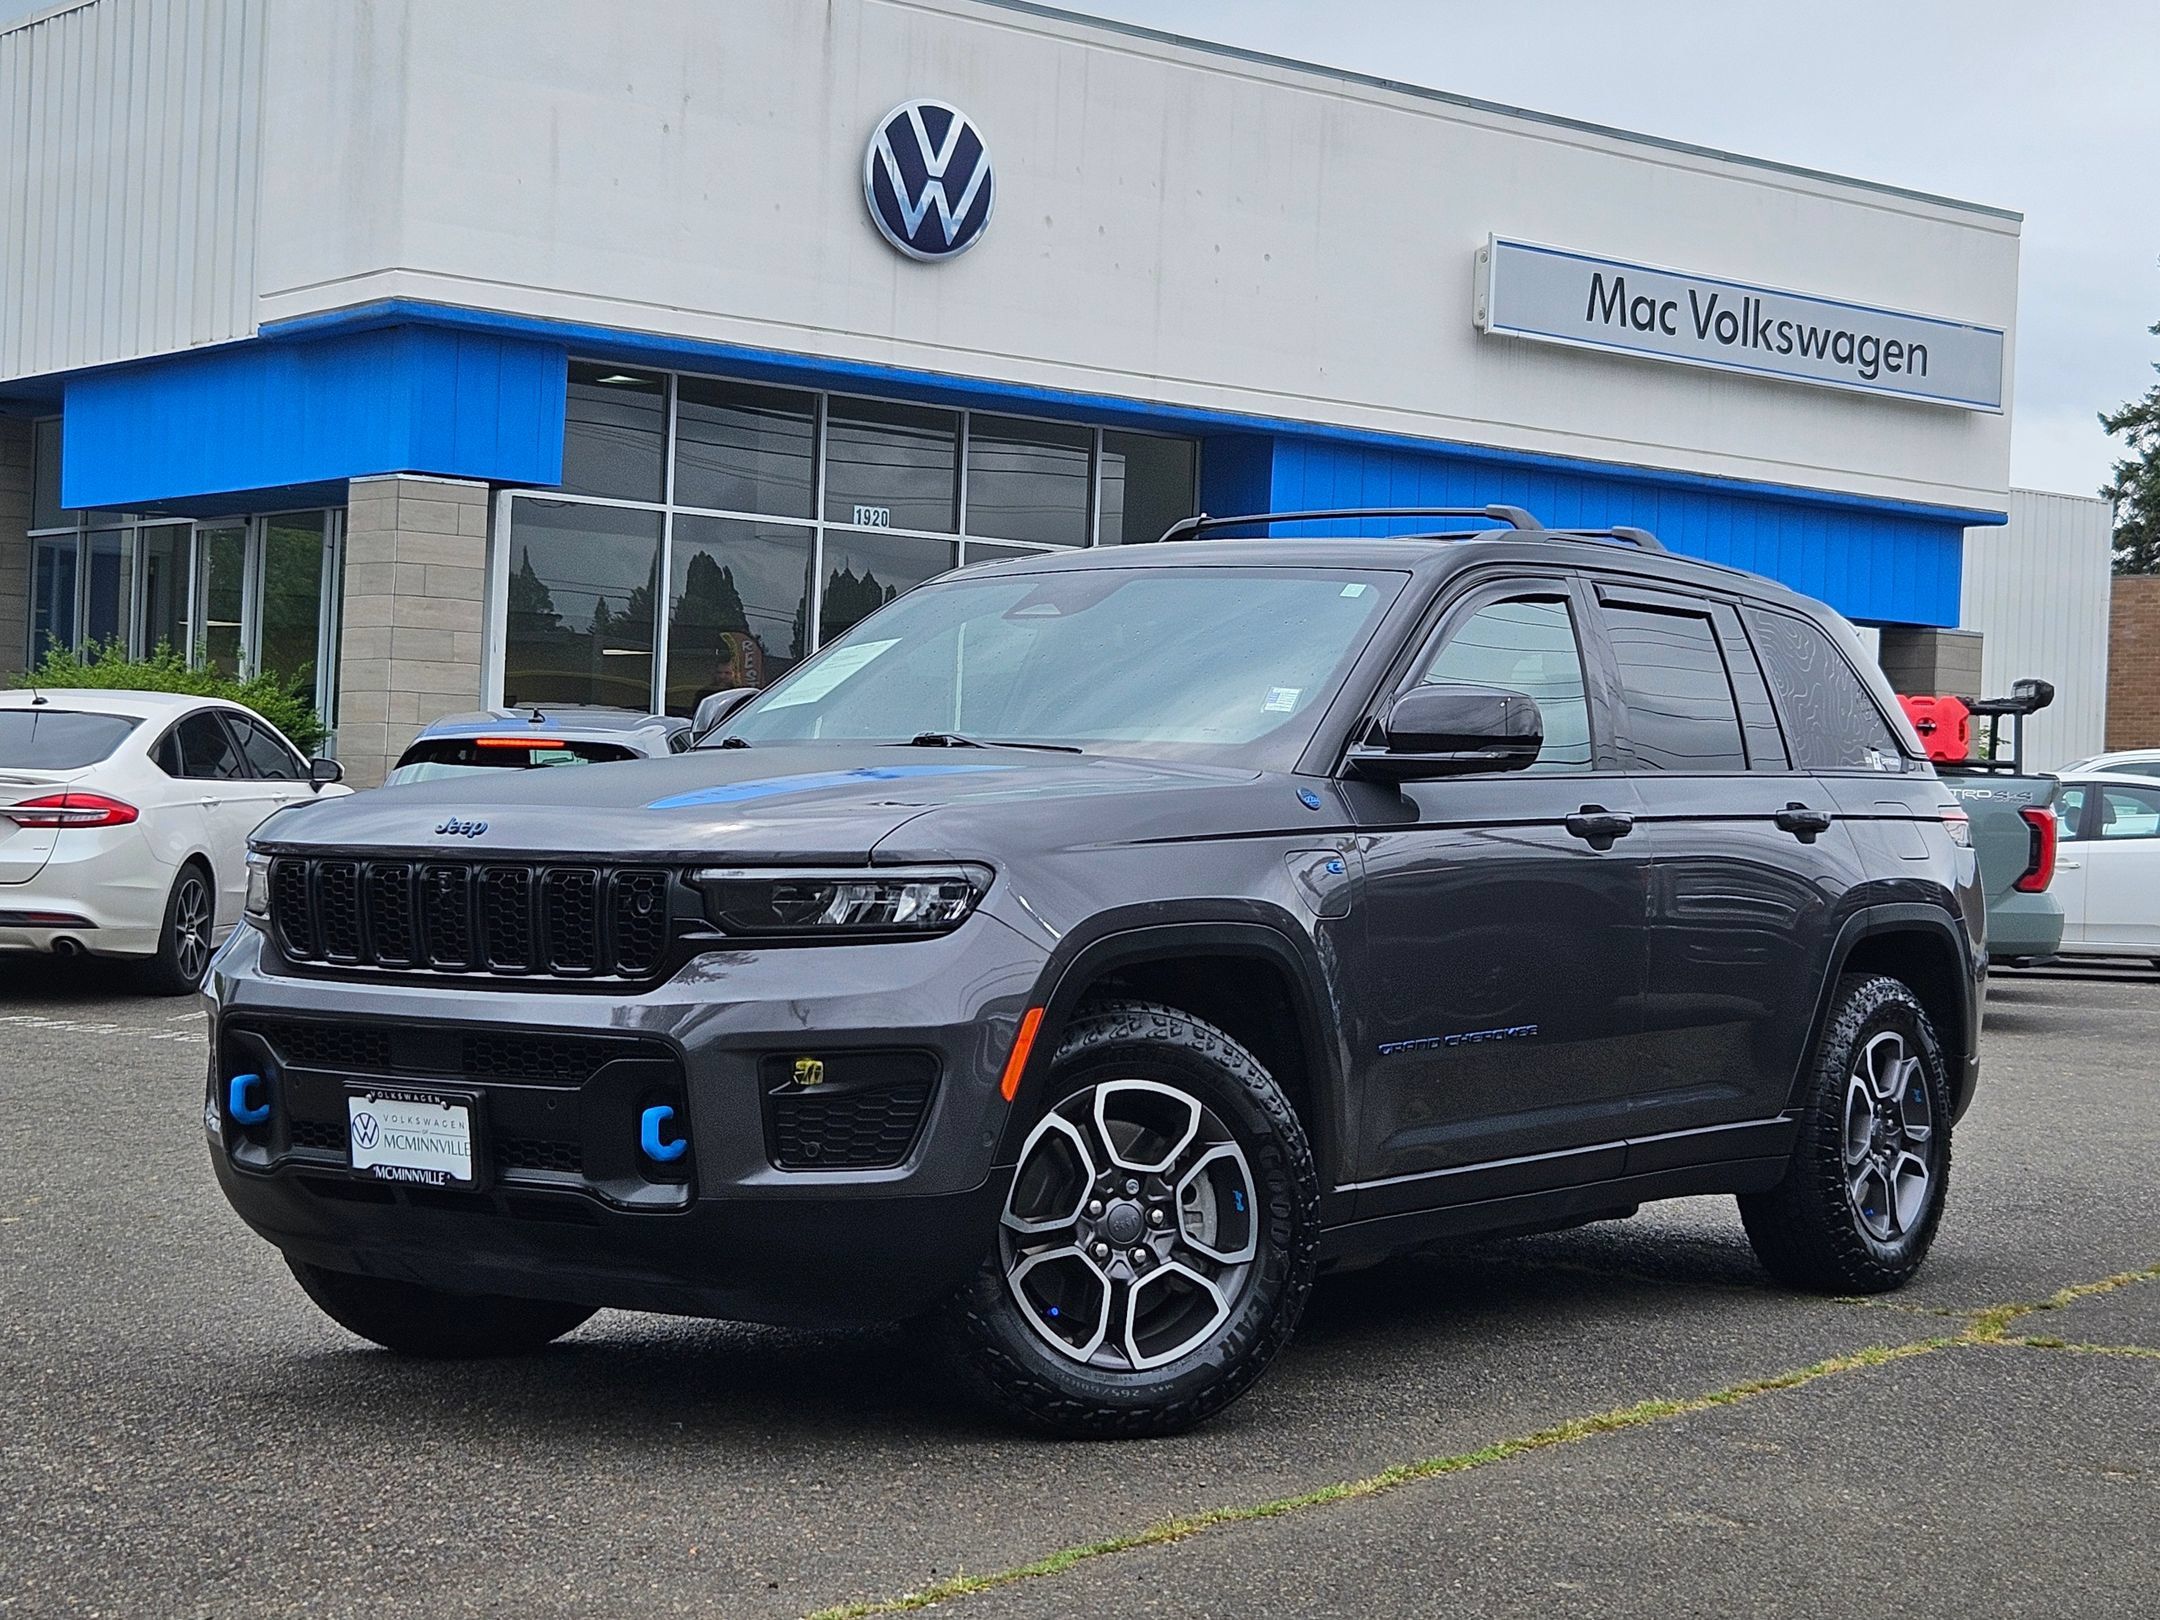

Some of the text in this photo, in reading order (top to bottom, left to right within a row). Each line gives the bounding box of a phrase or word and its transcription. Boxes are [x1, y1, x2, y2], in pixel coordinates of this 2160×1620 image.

[866, 99, 995, 263] VW
[1585, 272, 1928, 381] Mac Volkswagen
[856, 508, 888, 527] 1920
[434, 816, 488, 839] Jeep
[370, 1090, 441, 1103] VOLKSWAGEN
[383, 1114, 465, 1130] VOLKSWAGEN
[384, 1134, 471, 1157] MCMINNVILLE
